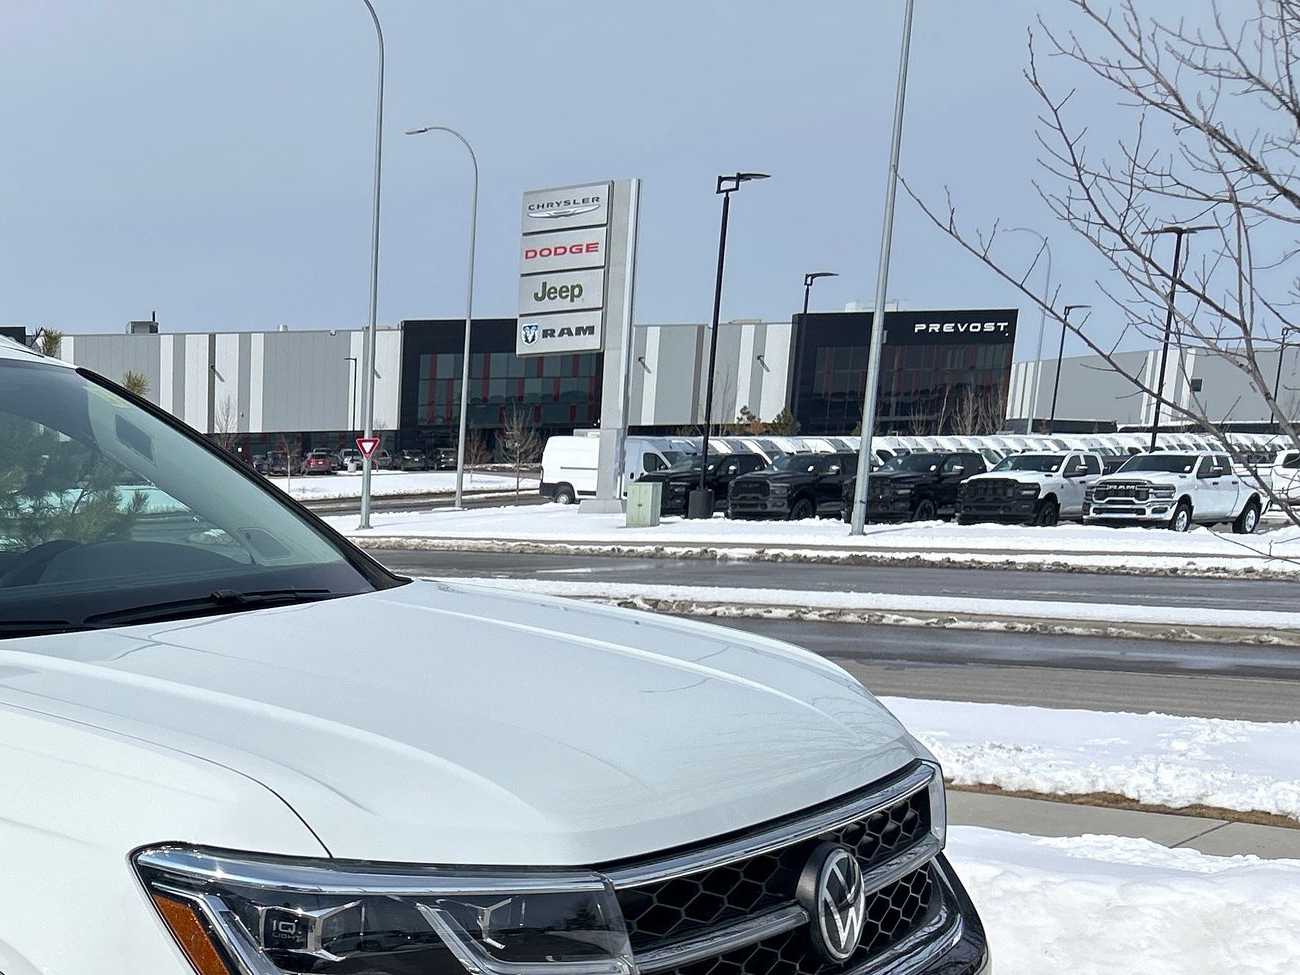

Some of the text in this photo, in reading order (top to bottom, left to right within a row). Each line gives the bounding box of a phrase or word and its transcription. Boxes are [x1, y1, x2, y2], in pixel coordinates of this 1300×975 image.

[528, 196, 600, 211] CHRYSLER
[524, 242, 599, 260] DODGE
[533, 281, 583, 302] Jeep
[541, 325, 595, 339] RAM
[914, 322, 1009, 333] PREVOST
